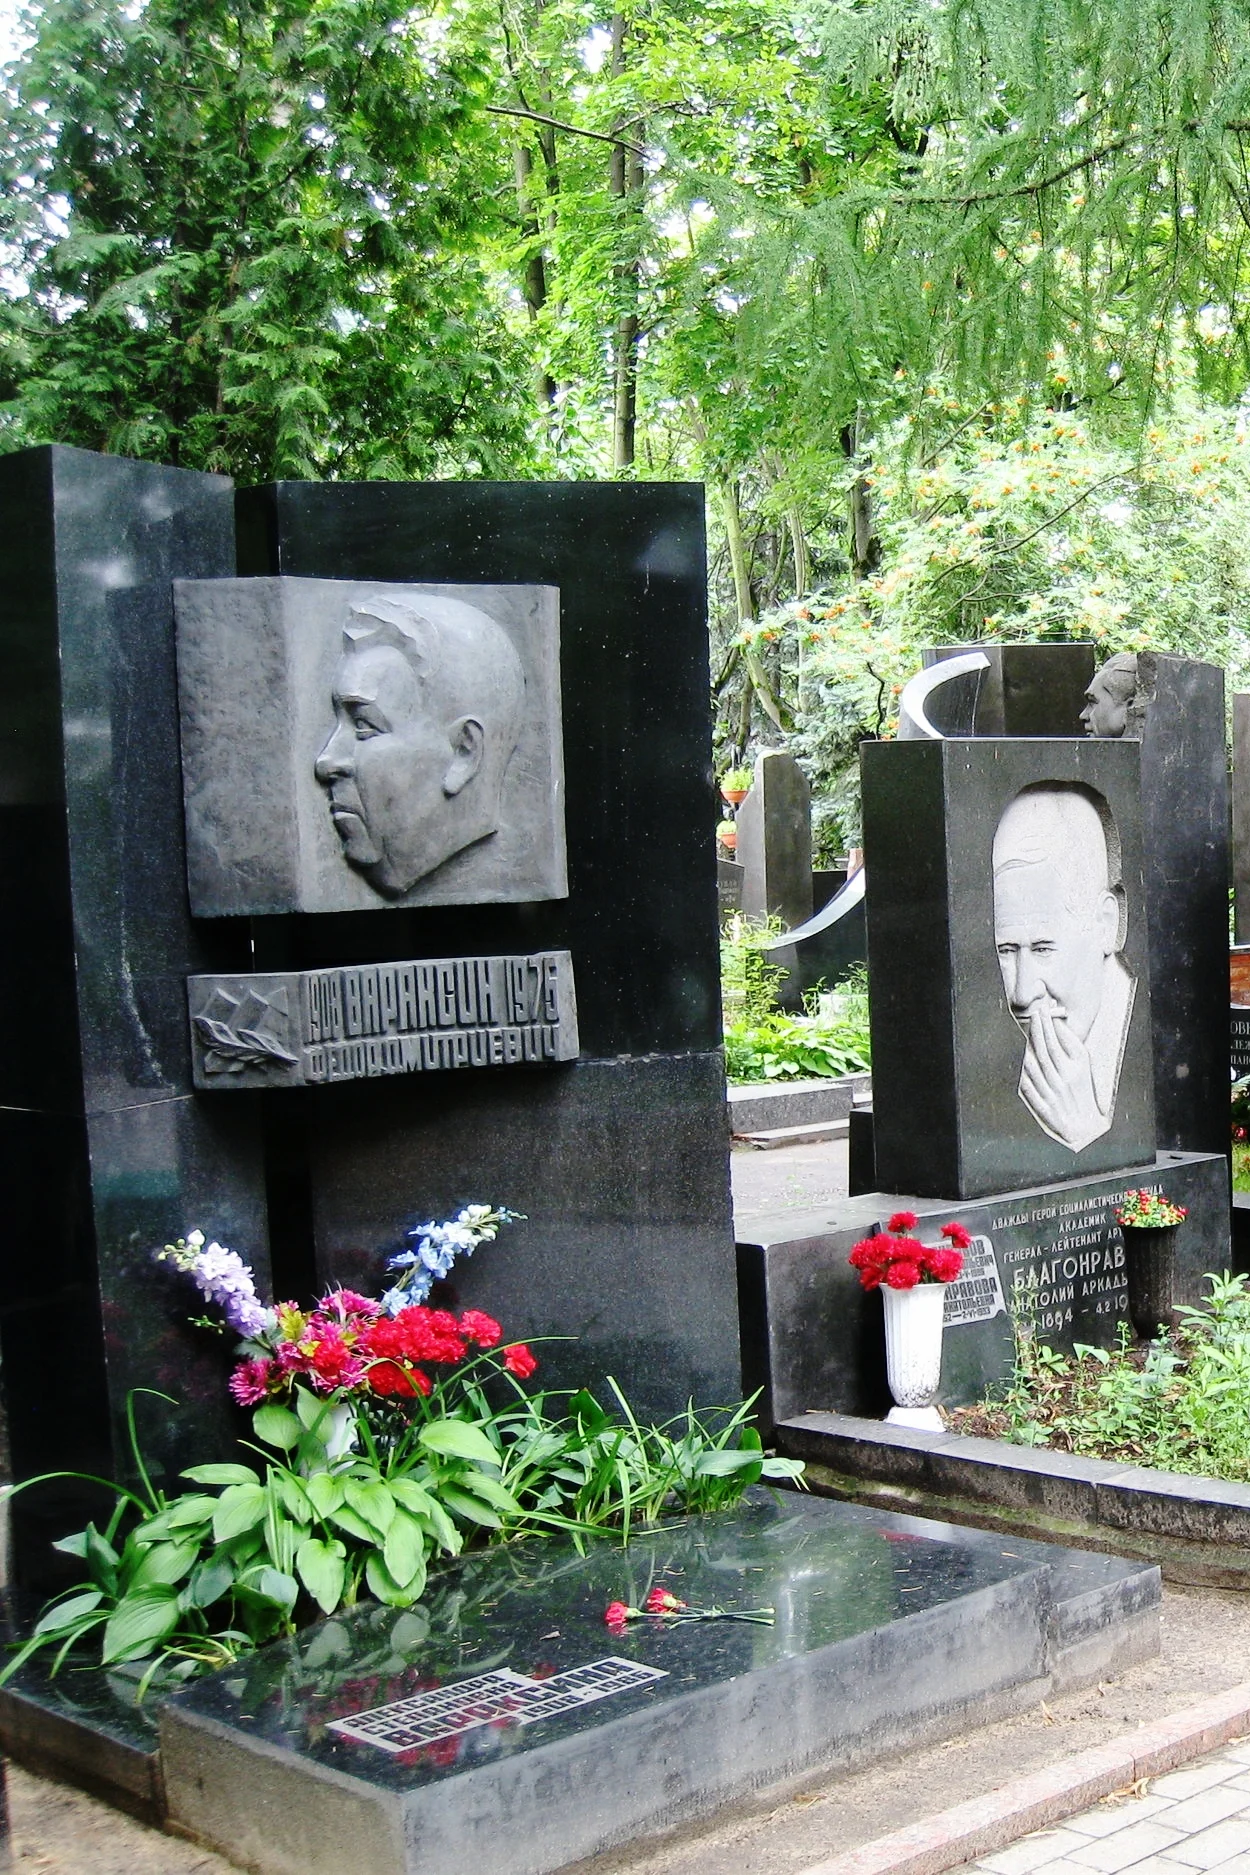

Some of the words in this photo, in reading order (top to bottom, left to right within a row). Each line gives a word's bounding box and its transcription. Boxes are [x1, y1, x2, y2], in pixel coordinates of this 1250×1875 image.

[345, 959, 498, 1037] ВАРАКСИН
[991, 1213, 1029, 1230] ДВАЖДЫ
[1032, 1204, 1057, 1222] ГЕРОЙ
[1059, 1212, 1107, 1234] АКАДЕМИК
[1012, 1245, 1126, 1291] БЛАГОНРАВ
[944, 1277, 998, 1300] НРАВОВА
[1082, 1272, 1128, 1296] АРКАДЬ
[1041, 1307, 1073, 1331] 1894
[1114, 1294, 1129, 1312] 19
[379, 1661, 636, 1747] ВАРАКСИНА
[519, 1694, 584, 1718] 1908
